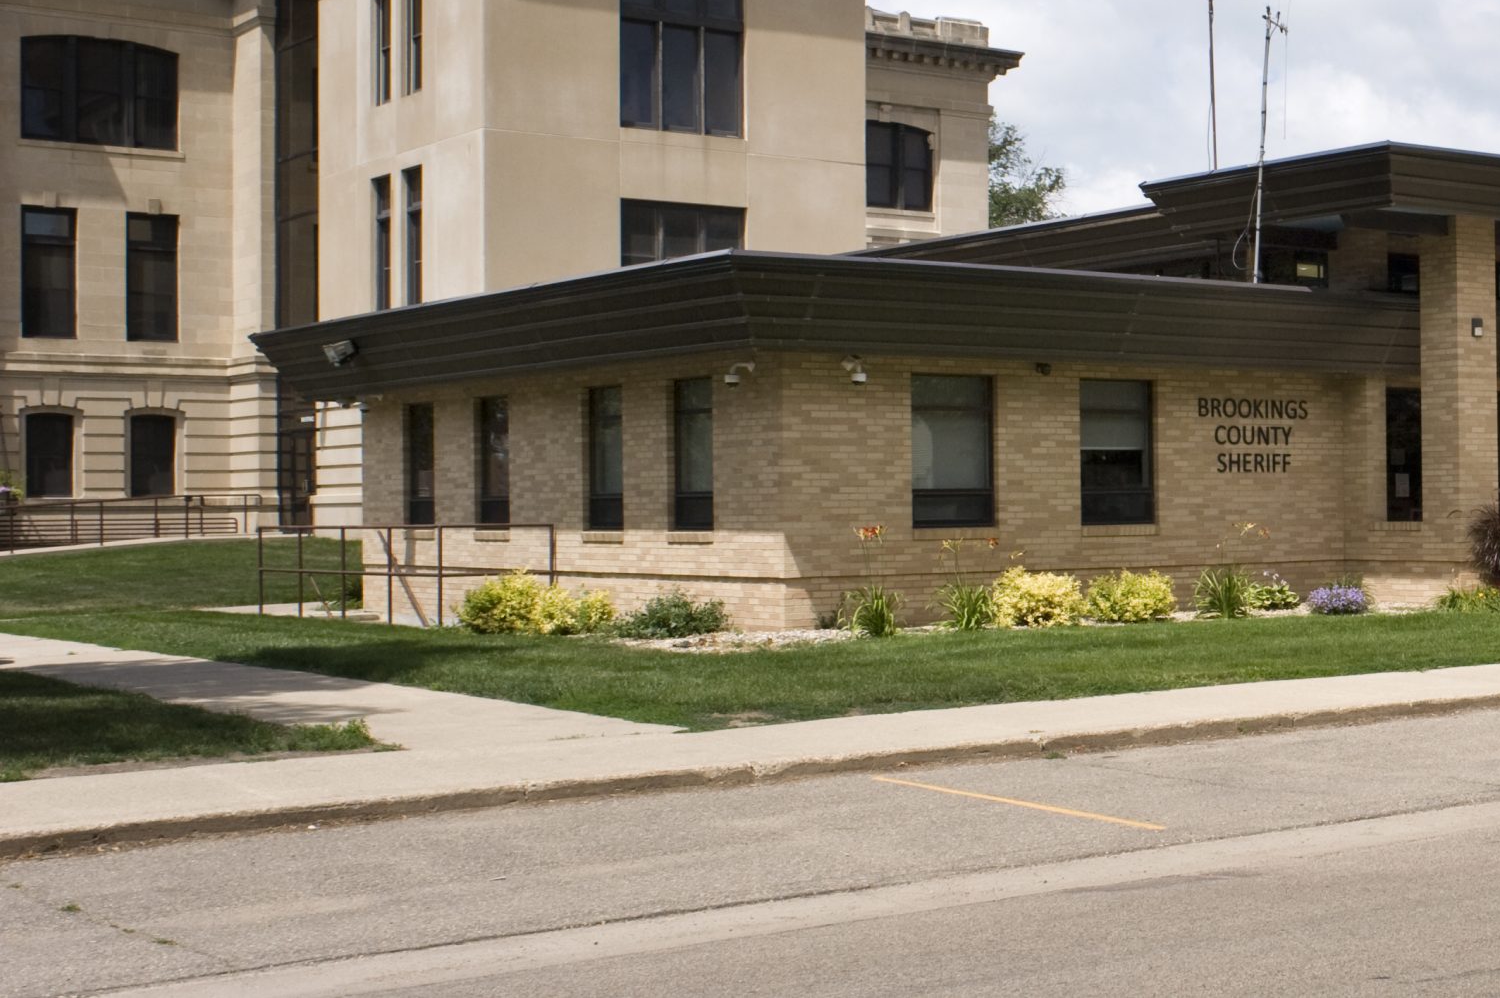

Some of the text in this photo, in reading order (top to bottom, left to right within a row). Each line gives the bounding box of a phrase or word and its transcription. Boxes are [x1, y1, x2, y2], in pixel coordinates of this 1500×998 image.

[1198, 398, 1308, 419] BROOKINGS
[1214, 425, 1292, 445] COUNTY
[1217, 453, 1291, 473] SHERIFF
